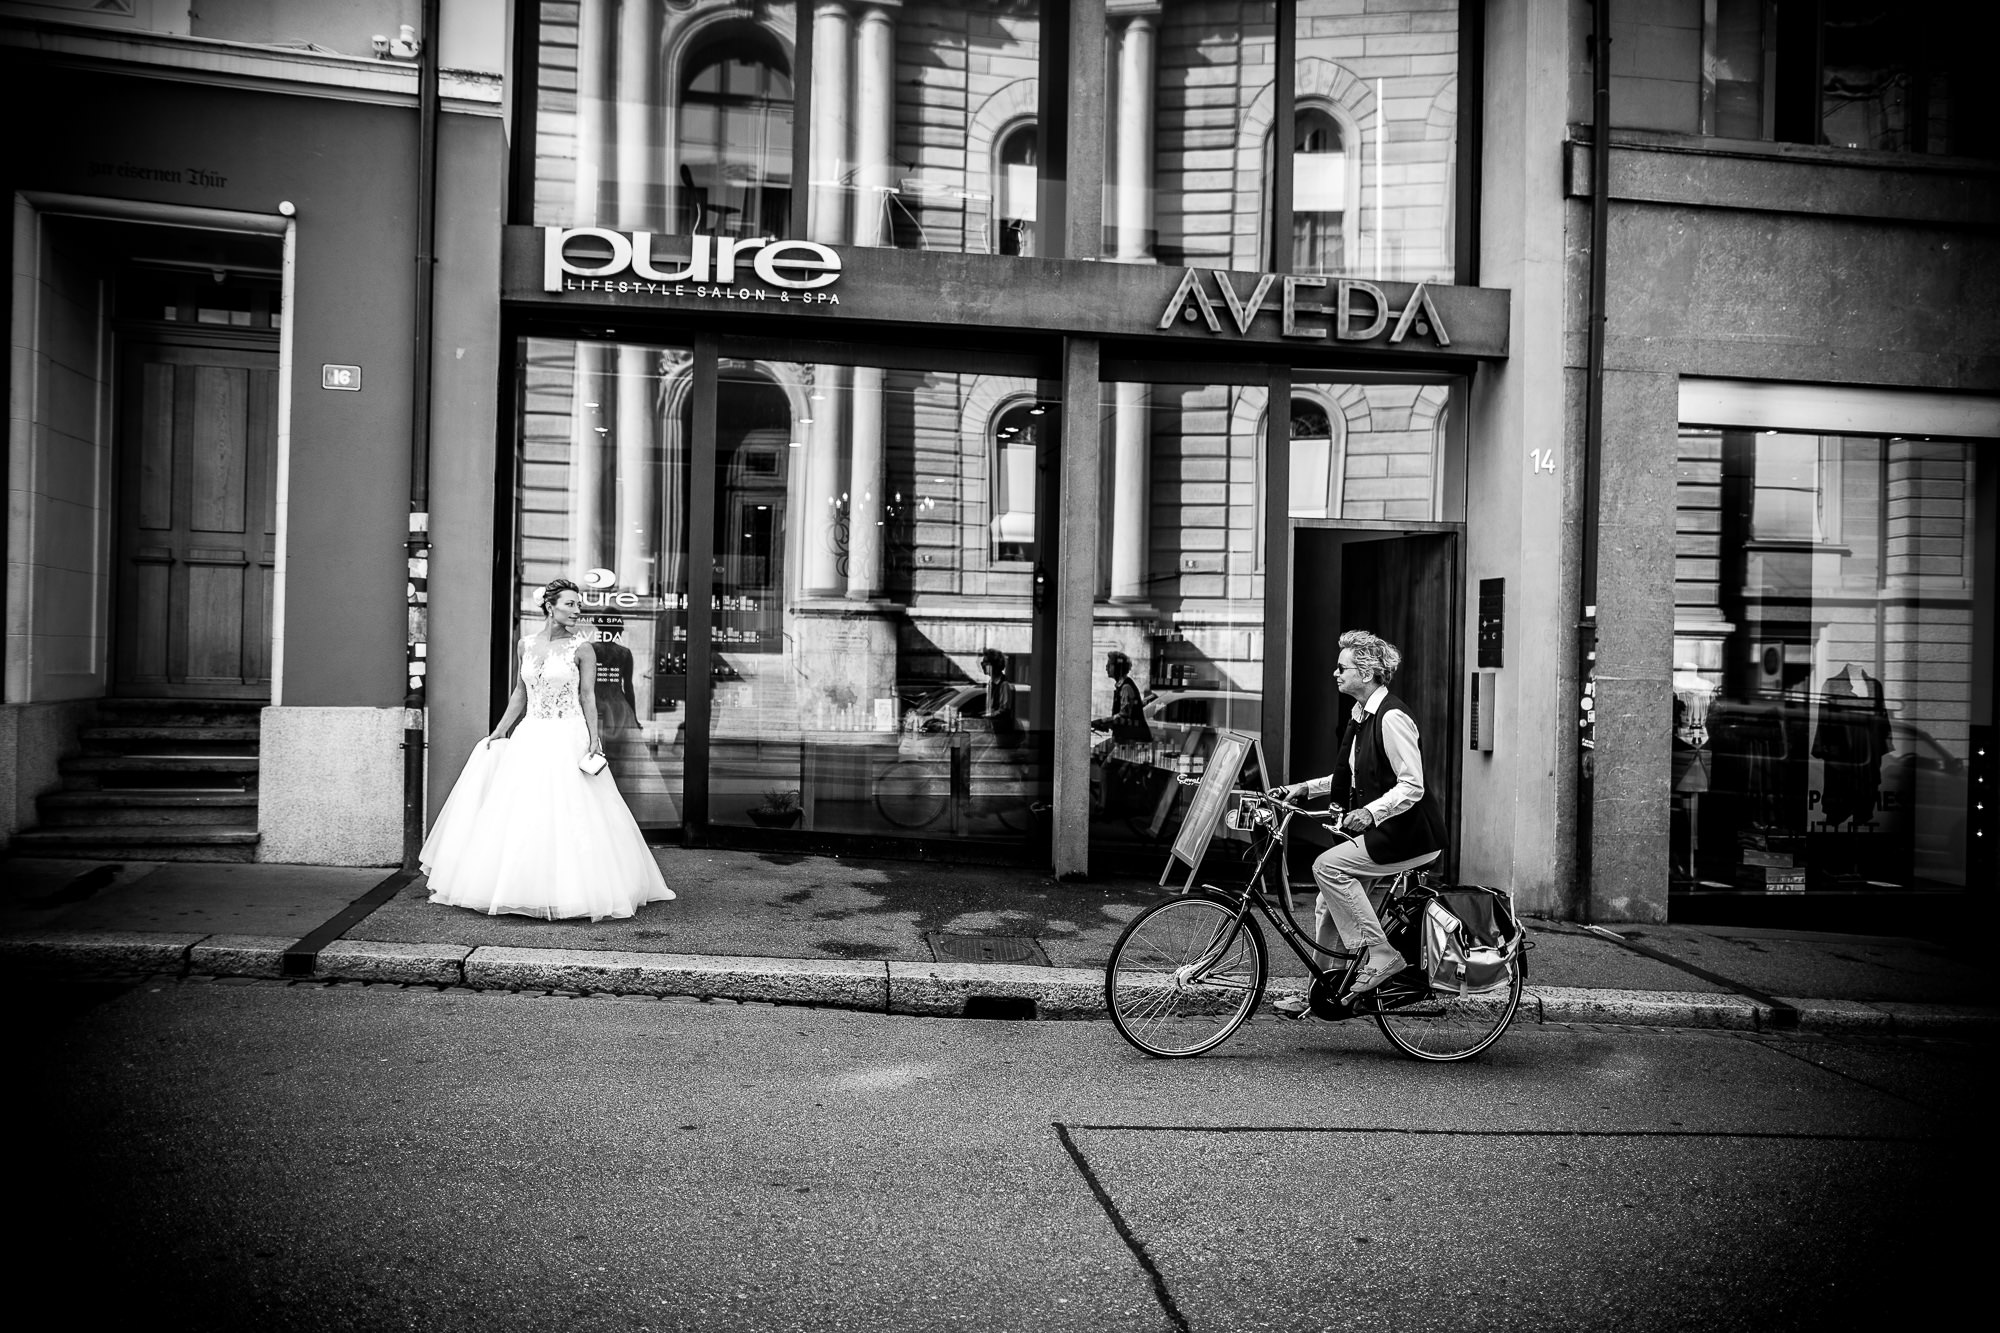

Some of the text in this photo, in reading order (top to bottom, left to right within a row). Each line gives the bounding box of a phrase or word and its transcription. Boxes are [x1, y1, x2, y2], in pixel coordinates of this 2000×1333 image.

[87, 160, 228, 189] zur eisernen Thür
[543, 226, 843, 292] pure
[566, 278, 841, 306] LIFESTYLE SALON & SPA
[1156, 266, 1451, 348] AVEDA
[333, 368, 352, 385] 16
[1529, 447, 1556, 474] 14
[597, 616, 604, 624] &
[575, 630, 624, 643] AVEDA
